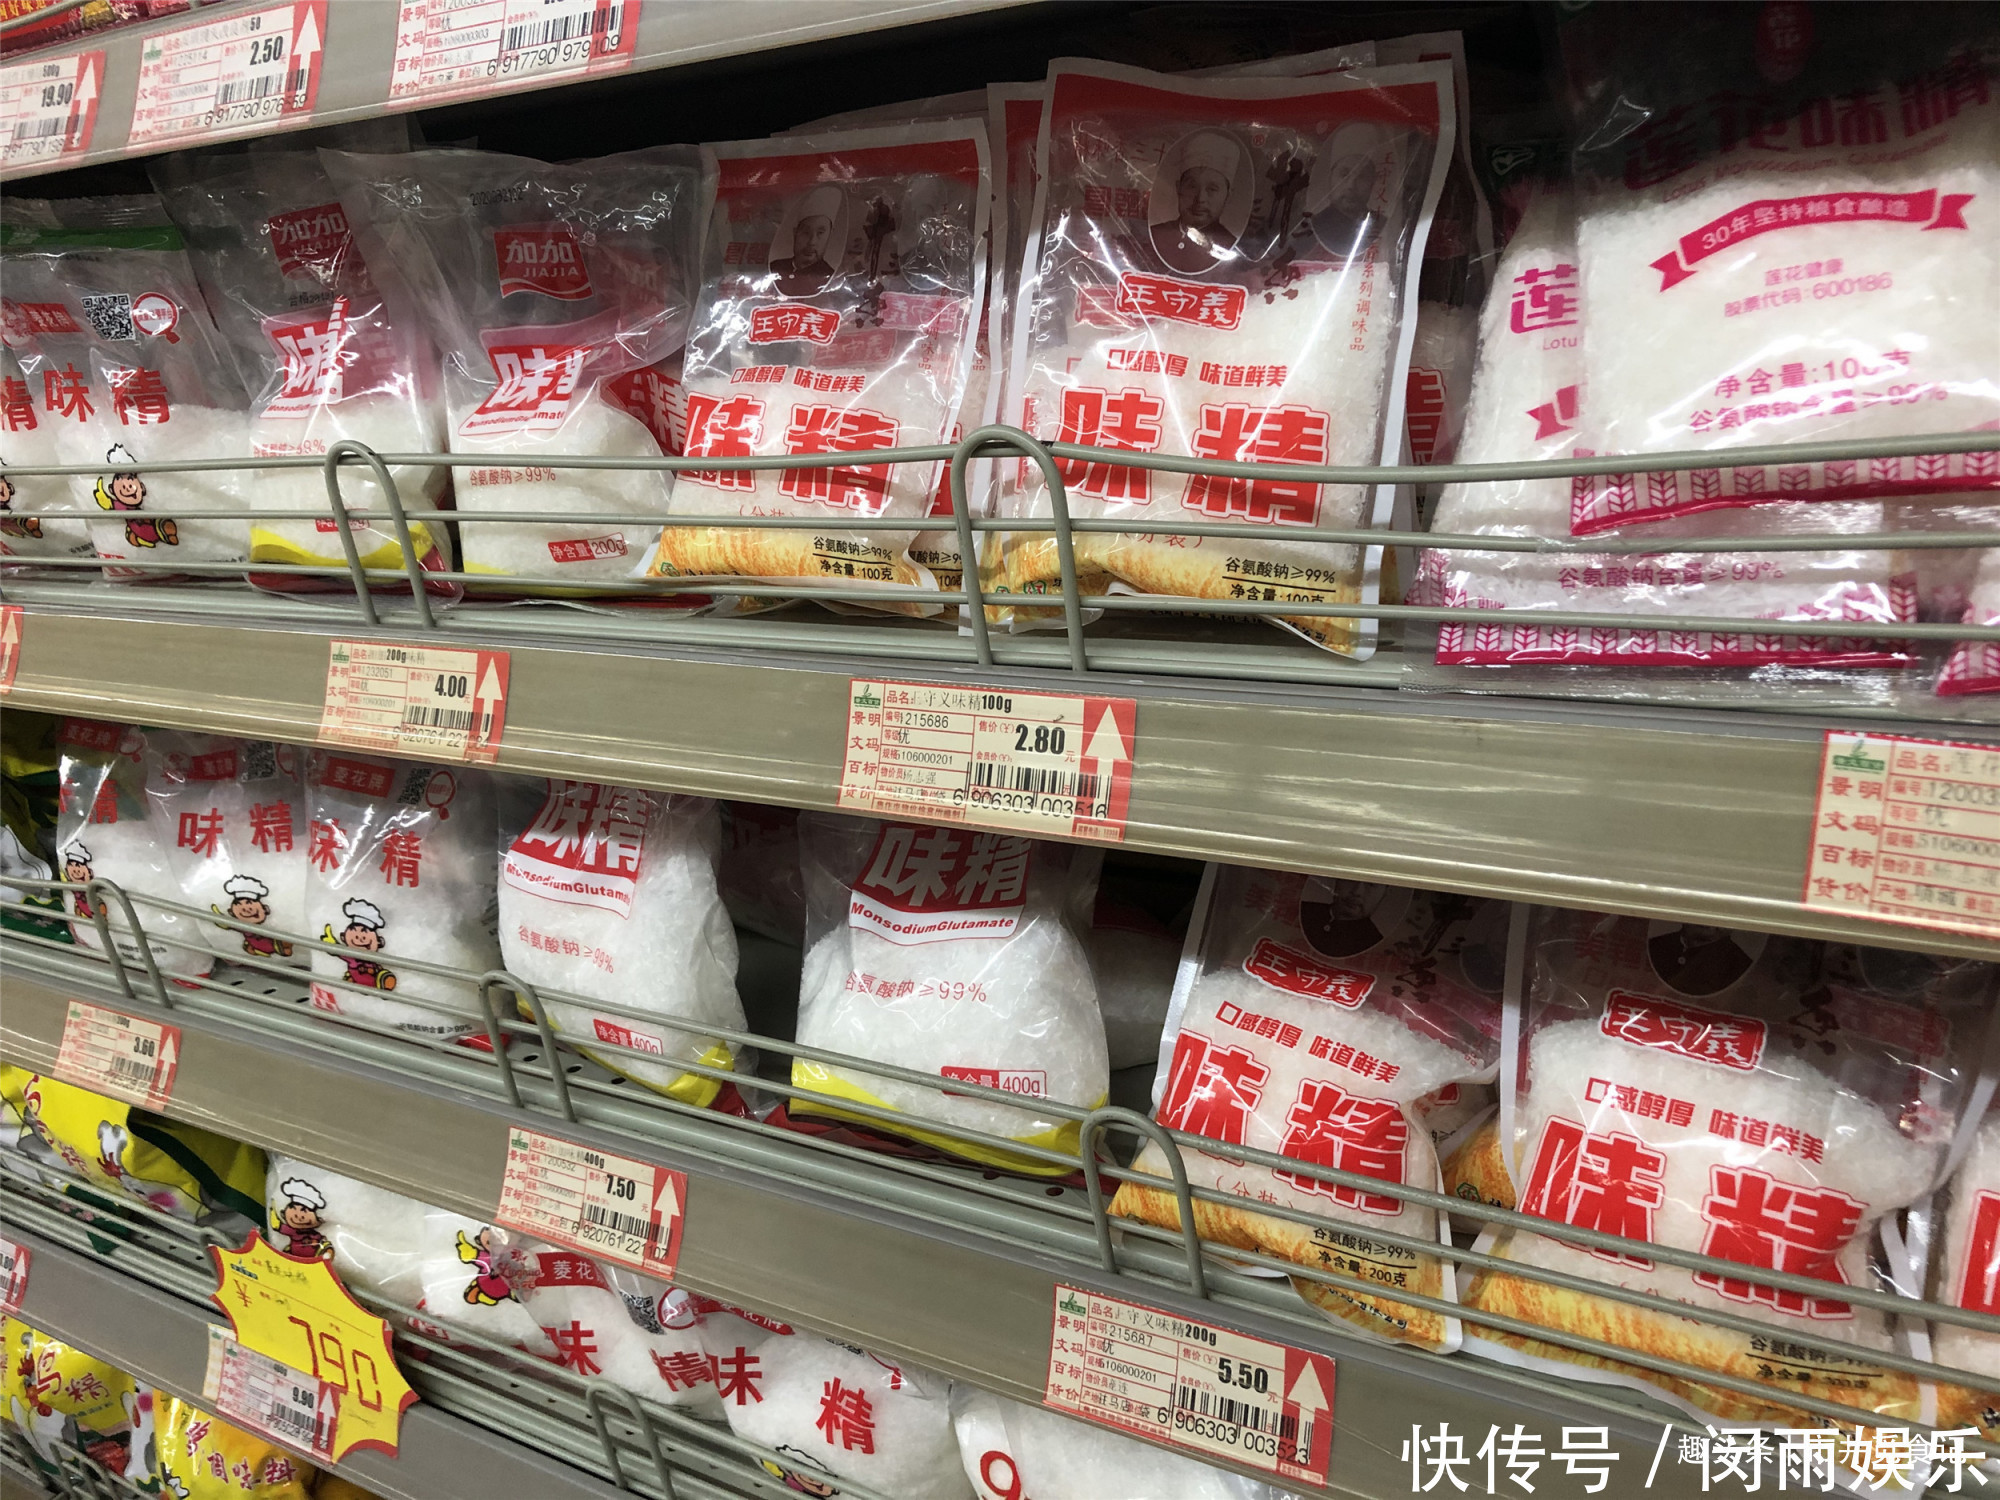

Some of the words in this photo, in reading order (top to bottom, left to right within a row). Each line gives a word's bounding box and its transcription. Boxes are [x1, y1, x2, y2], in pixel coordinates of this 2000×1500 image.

[250, 36, 284, 66] 2.50
[563, 34, 621, 62] 979109
[279, 212, 346, 245] 加加
[505, 239, 575, 264] 加加
[523, 266, 579, 278] JIAJIA
[731, 364, 788, 385] 口感醇厚
[793, 367, 866, 394] 味道鲜美
[1106, 348, 1190, 378] 口感醇厚
[1199, 360, 1288, 388] 味道鲜美
[43, 362, 170, 425] 味精
[677, 391, 901, 513] 味精
[1050, 389, 1329, 525] 味精
[813, 535, 893, 561] 谷氨酸钠≥99%
[819, 559, 894, 582] 净含量:100克
[1225, 556, 1337, 585] 谷氨酸钠≥99%
[435, 674, 467, 699] 4.00
[898, 728, 911, 745] 优
[1014, 723, 1066, 754] 2.80
[1064, 750, 1076, 763] 元
[333, 766, 386, 791] 菱花牌
[952, 788, 965, 806] 6
[971, 790, 1035, 814] 906303
[1040, 797, 1107, 822] 003516
[177, 799, 294, 857] 味精
[522, 779, 649, 872] 味精
[308, 817, 423, 888] 味精
[862, 827, 1033, 907] 味精
[851, 902, 1014, 935] MonsodiumGlutamate
[845, 971, 987, 1002] 谷氨酸钠≥99%
[134, 1036, 155, 1058] 3.60
[1215, 1000, 1304, 1049] 口感醇厚
[1307, 1035, 1401, 1084] 味道鲜美
[1157, 1029, 1409, 1215] 味精
[1585, 1077, 1696, 1128] 口感醇厚
[1708, 1108, 1825, 1165] 味道鲜美
[606, 1173, 636, 1201] 7.50
[1519, 1116, 1869, 1320] 味精
[582, 1223, 622, 1249] 920761
[1313, 1227, 1416, 1261] 谷氨酸钠≥99%
[552, 1259, 601, 1282] 菱花
[1318, 1251, 1408, 1288] 净含量:200克
[1217, 1357, 1269, 1394] 5.50
[292, 1386, 315, 1409] 9.90
[705, 1346, 876, 1455] 味精
[1157, 1407, 1168, 1424] 6
[1175, 1412, 1237, 1445] 906303
[1243, 1432, 1309, 1465] 003523
